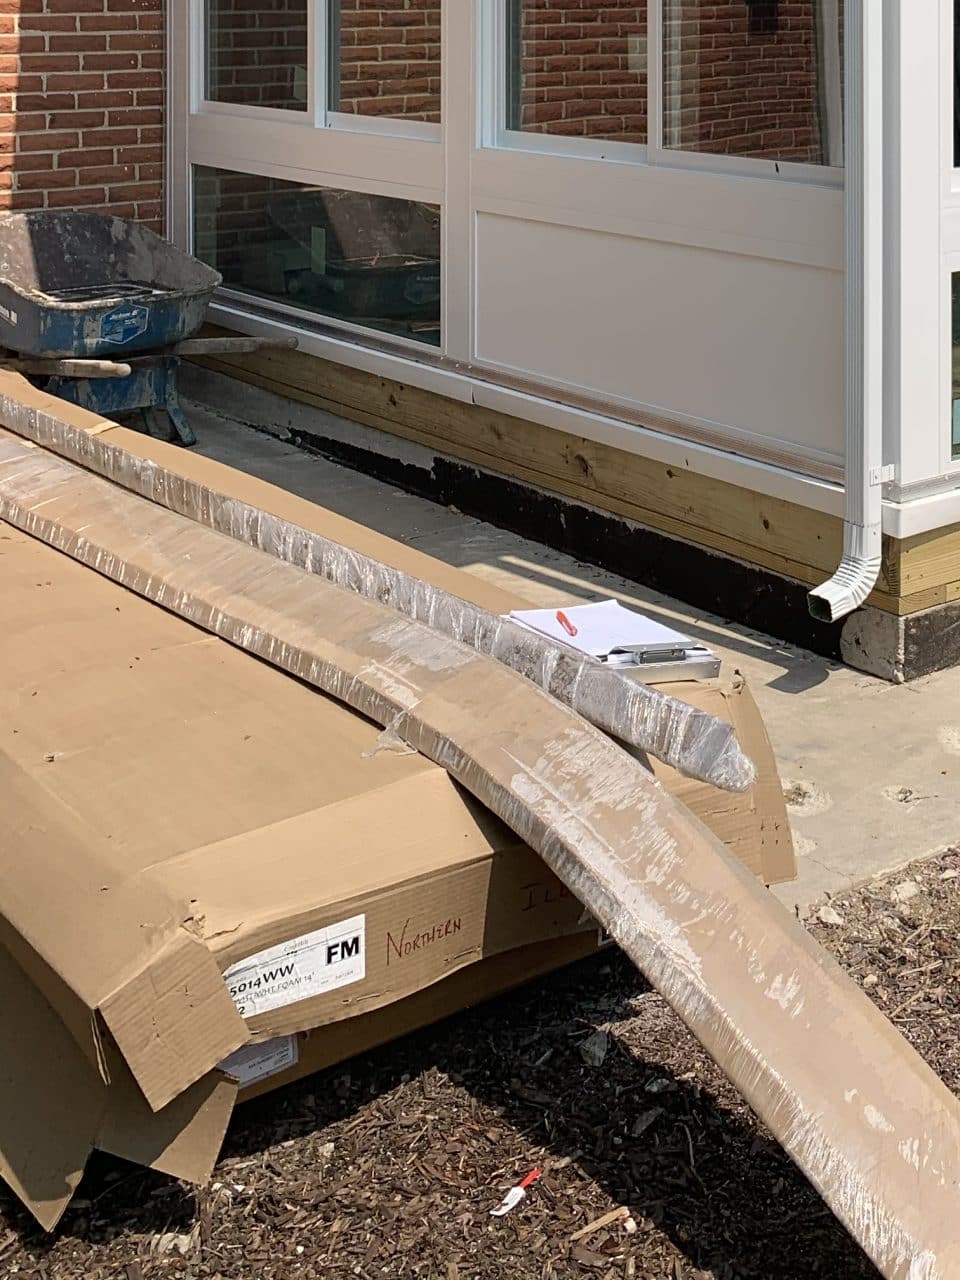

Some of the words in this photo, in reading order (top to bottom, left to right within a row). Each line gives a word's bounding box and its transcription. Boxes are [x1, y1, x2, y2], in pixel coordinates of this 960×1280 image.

[326, 936, 360, 965] FM
[386, 918, 462, 966] NORTHERN
[278, 977, 302, 990] FOAM
